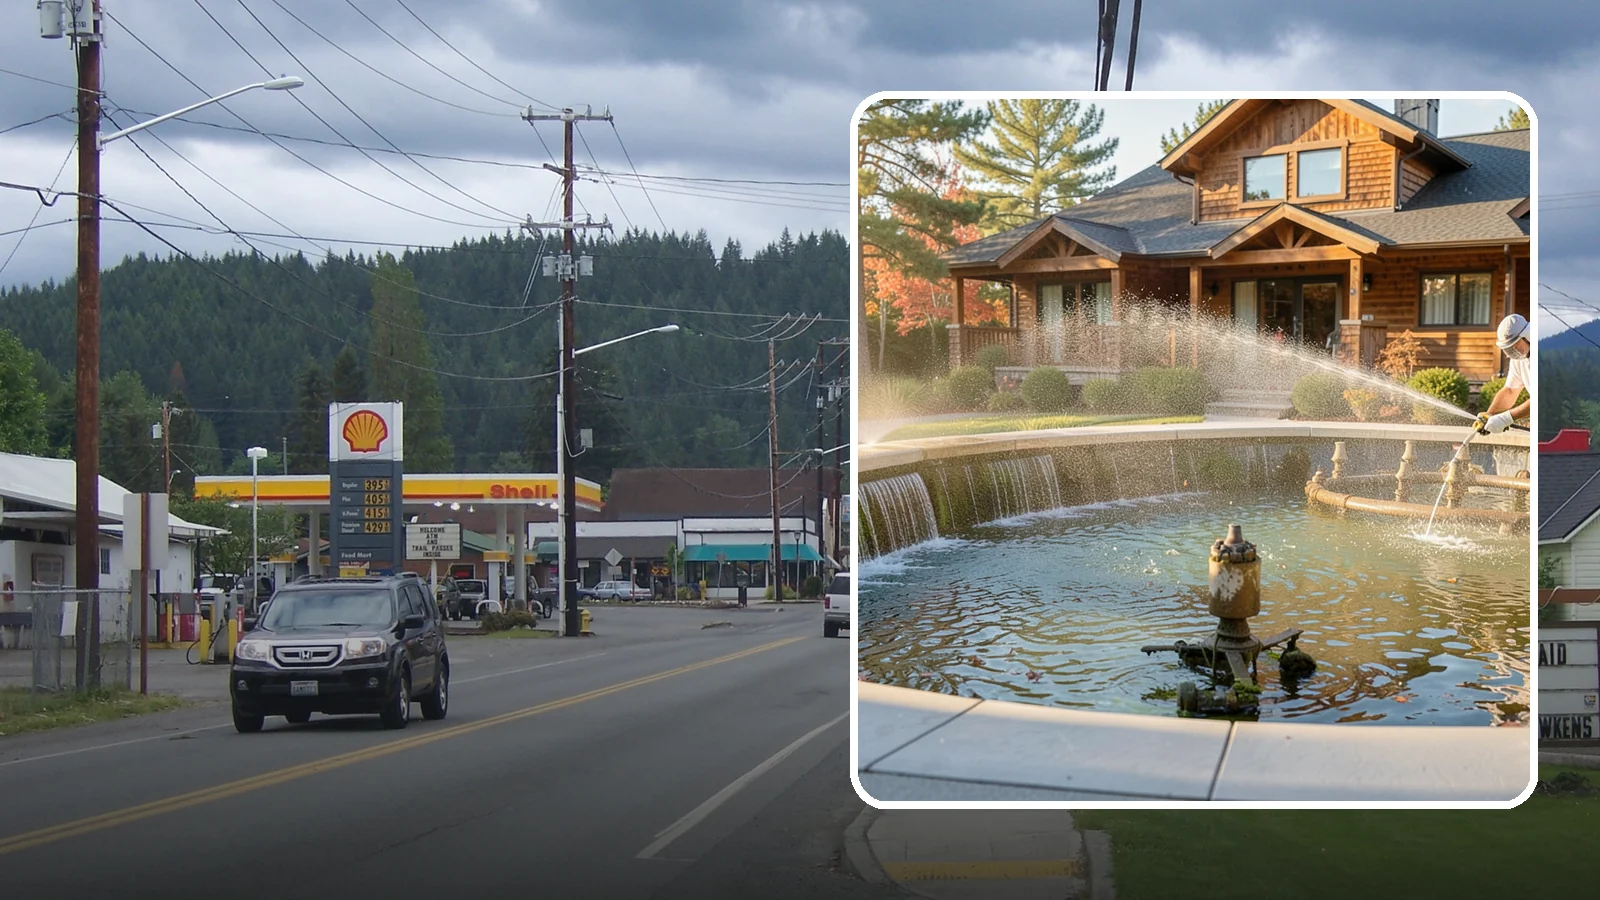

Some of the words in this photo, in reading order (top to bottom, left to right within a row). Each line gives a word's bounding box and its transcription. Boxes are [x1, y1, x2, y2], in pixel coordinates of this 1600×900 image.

[366, 480, 383, 490] 395
[490, 484, 547, 499] Shell
[366, 494, 383, 504] 405
[366, 508, 383, 518] 415
[366, 522, 383, 532] 429
